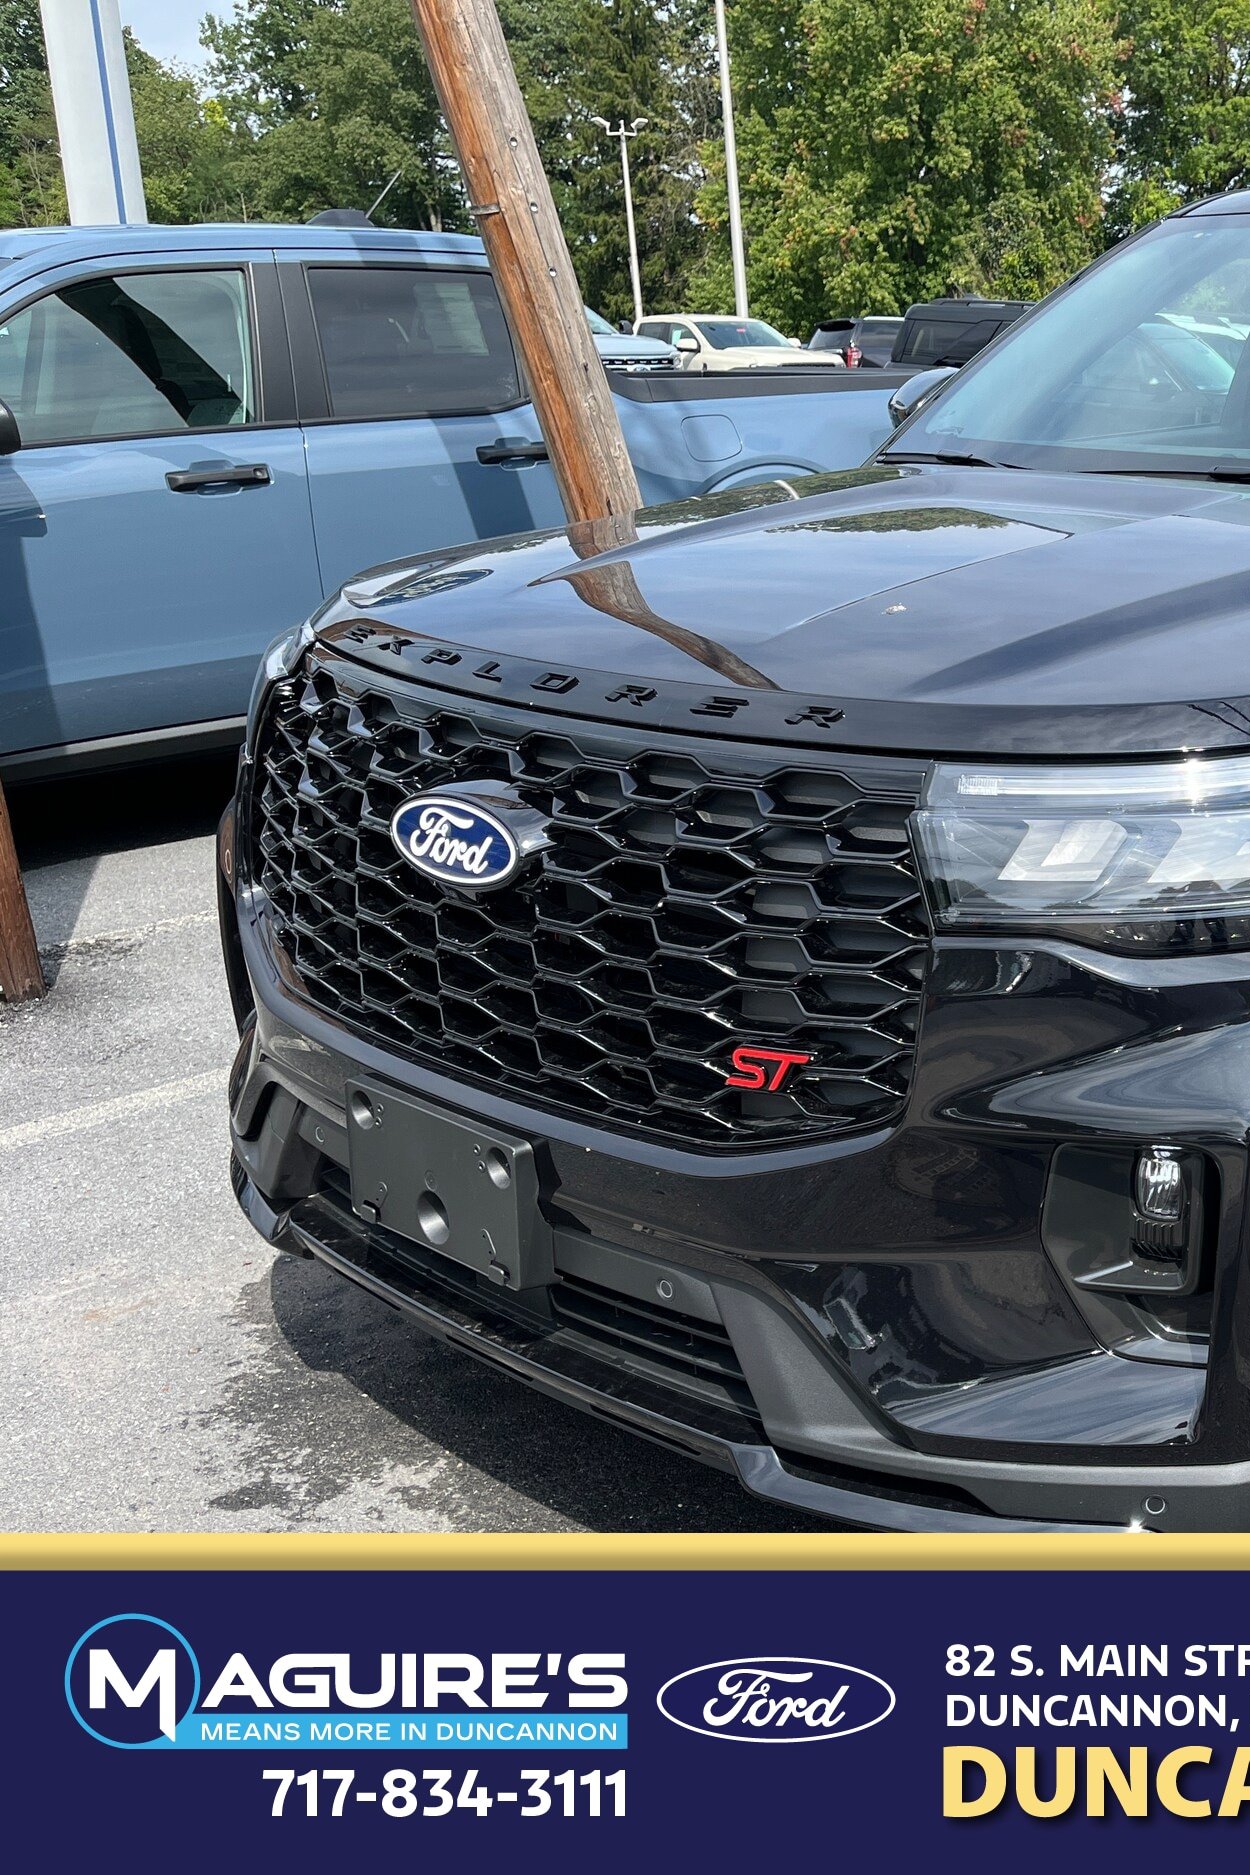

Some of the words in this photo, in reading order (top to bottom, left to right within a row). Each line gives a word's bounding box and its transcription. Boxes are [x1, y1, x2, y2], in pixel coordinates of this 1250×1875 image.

[344, 623, 846, 729] EXPLORER
[409, 806, 494, 875] Ford
[725, 1047, 810, 1092] ST
